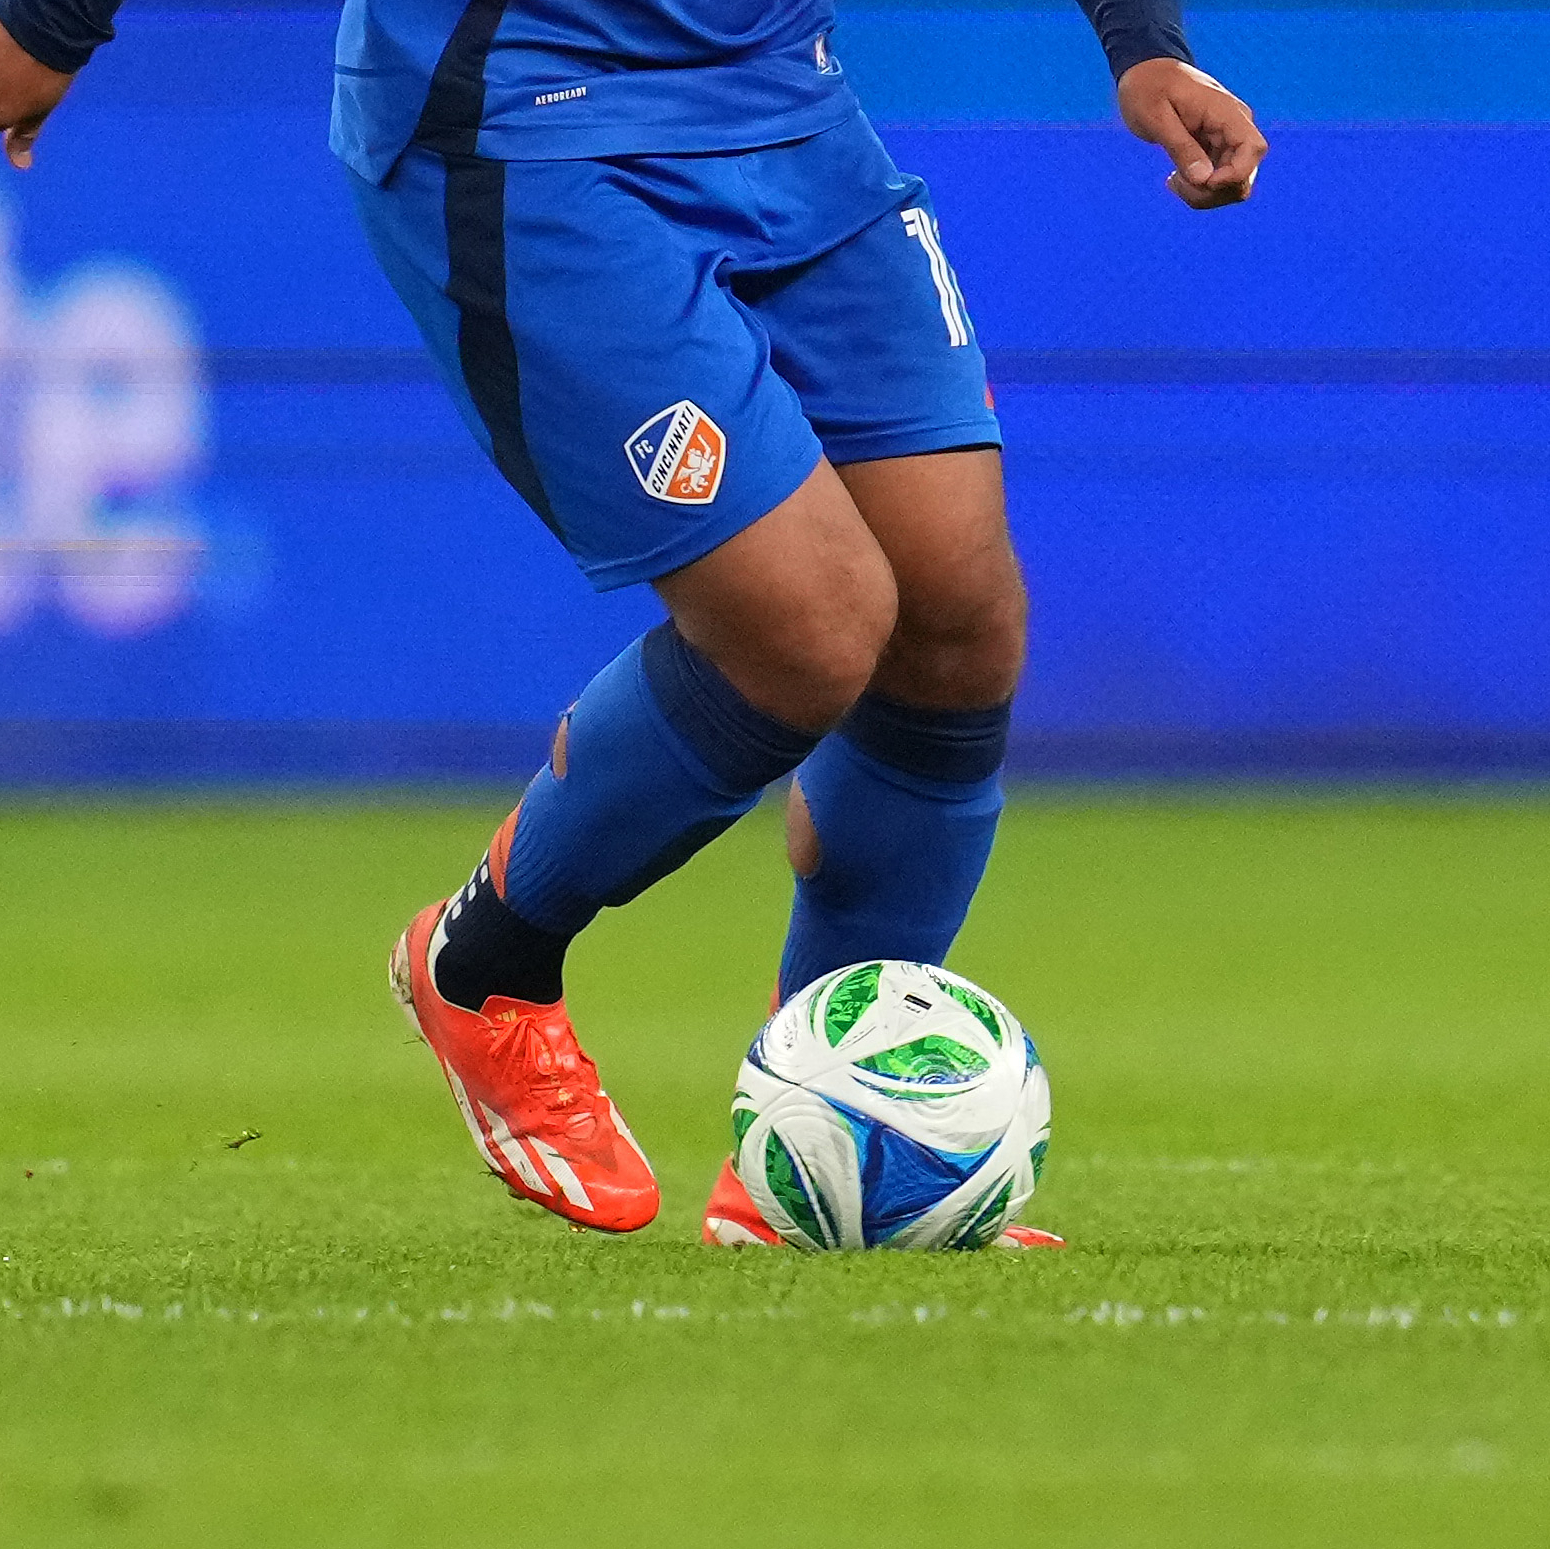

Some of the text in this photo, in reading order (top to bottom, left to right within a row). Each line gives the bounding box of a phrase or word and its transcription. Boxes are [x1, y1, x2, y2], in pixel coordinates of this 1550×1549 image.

[535, 86, 587, 106] AEROREADY
[634, 439, 654, 460] FC
[651, 405, 694, 494] CINCINNATI
